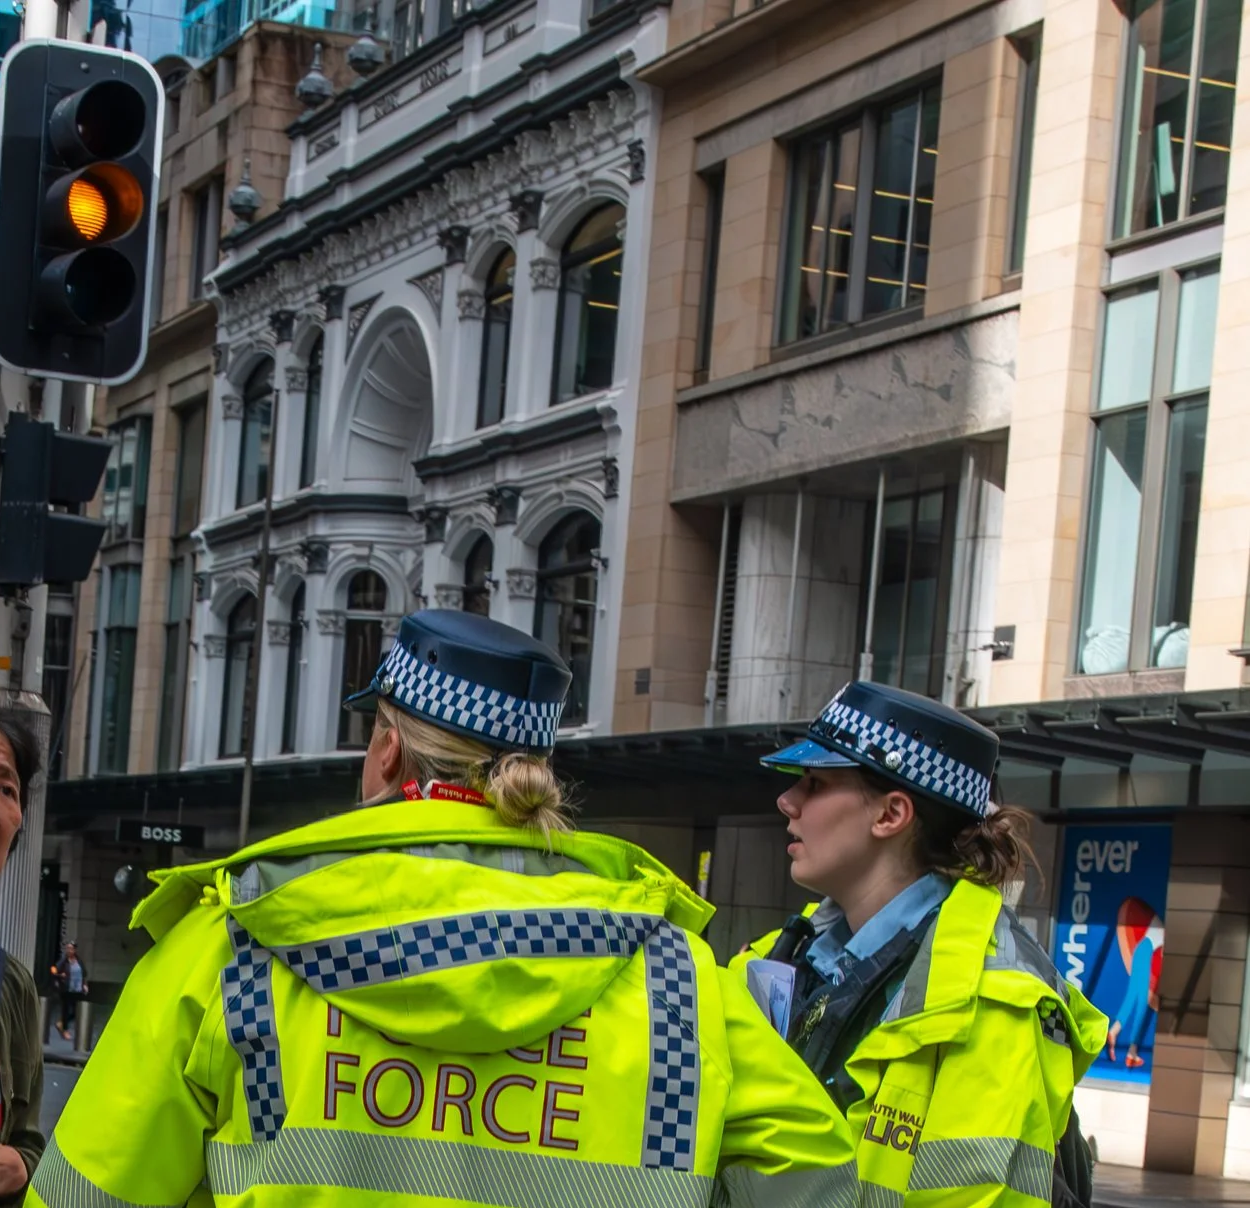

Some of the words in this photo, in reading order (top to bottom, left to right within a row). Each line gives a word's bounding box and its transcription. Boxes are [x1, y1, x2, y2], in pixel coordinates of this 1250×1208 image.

[141, 826, 182, 842] BOSS
[1076, 839, 1139, 874] ever
[324, 1051, 585, 1151] FORCE
